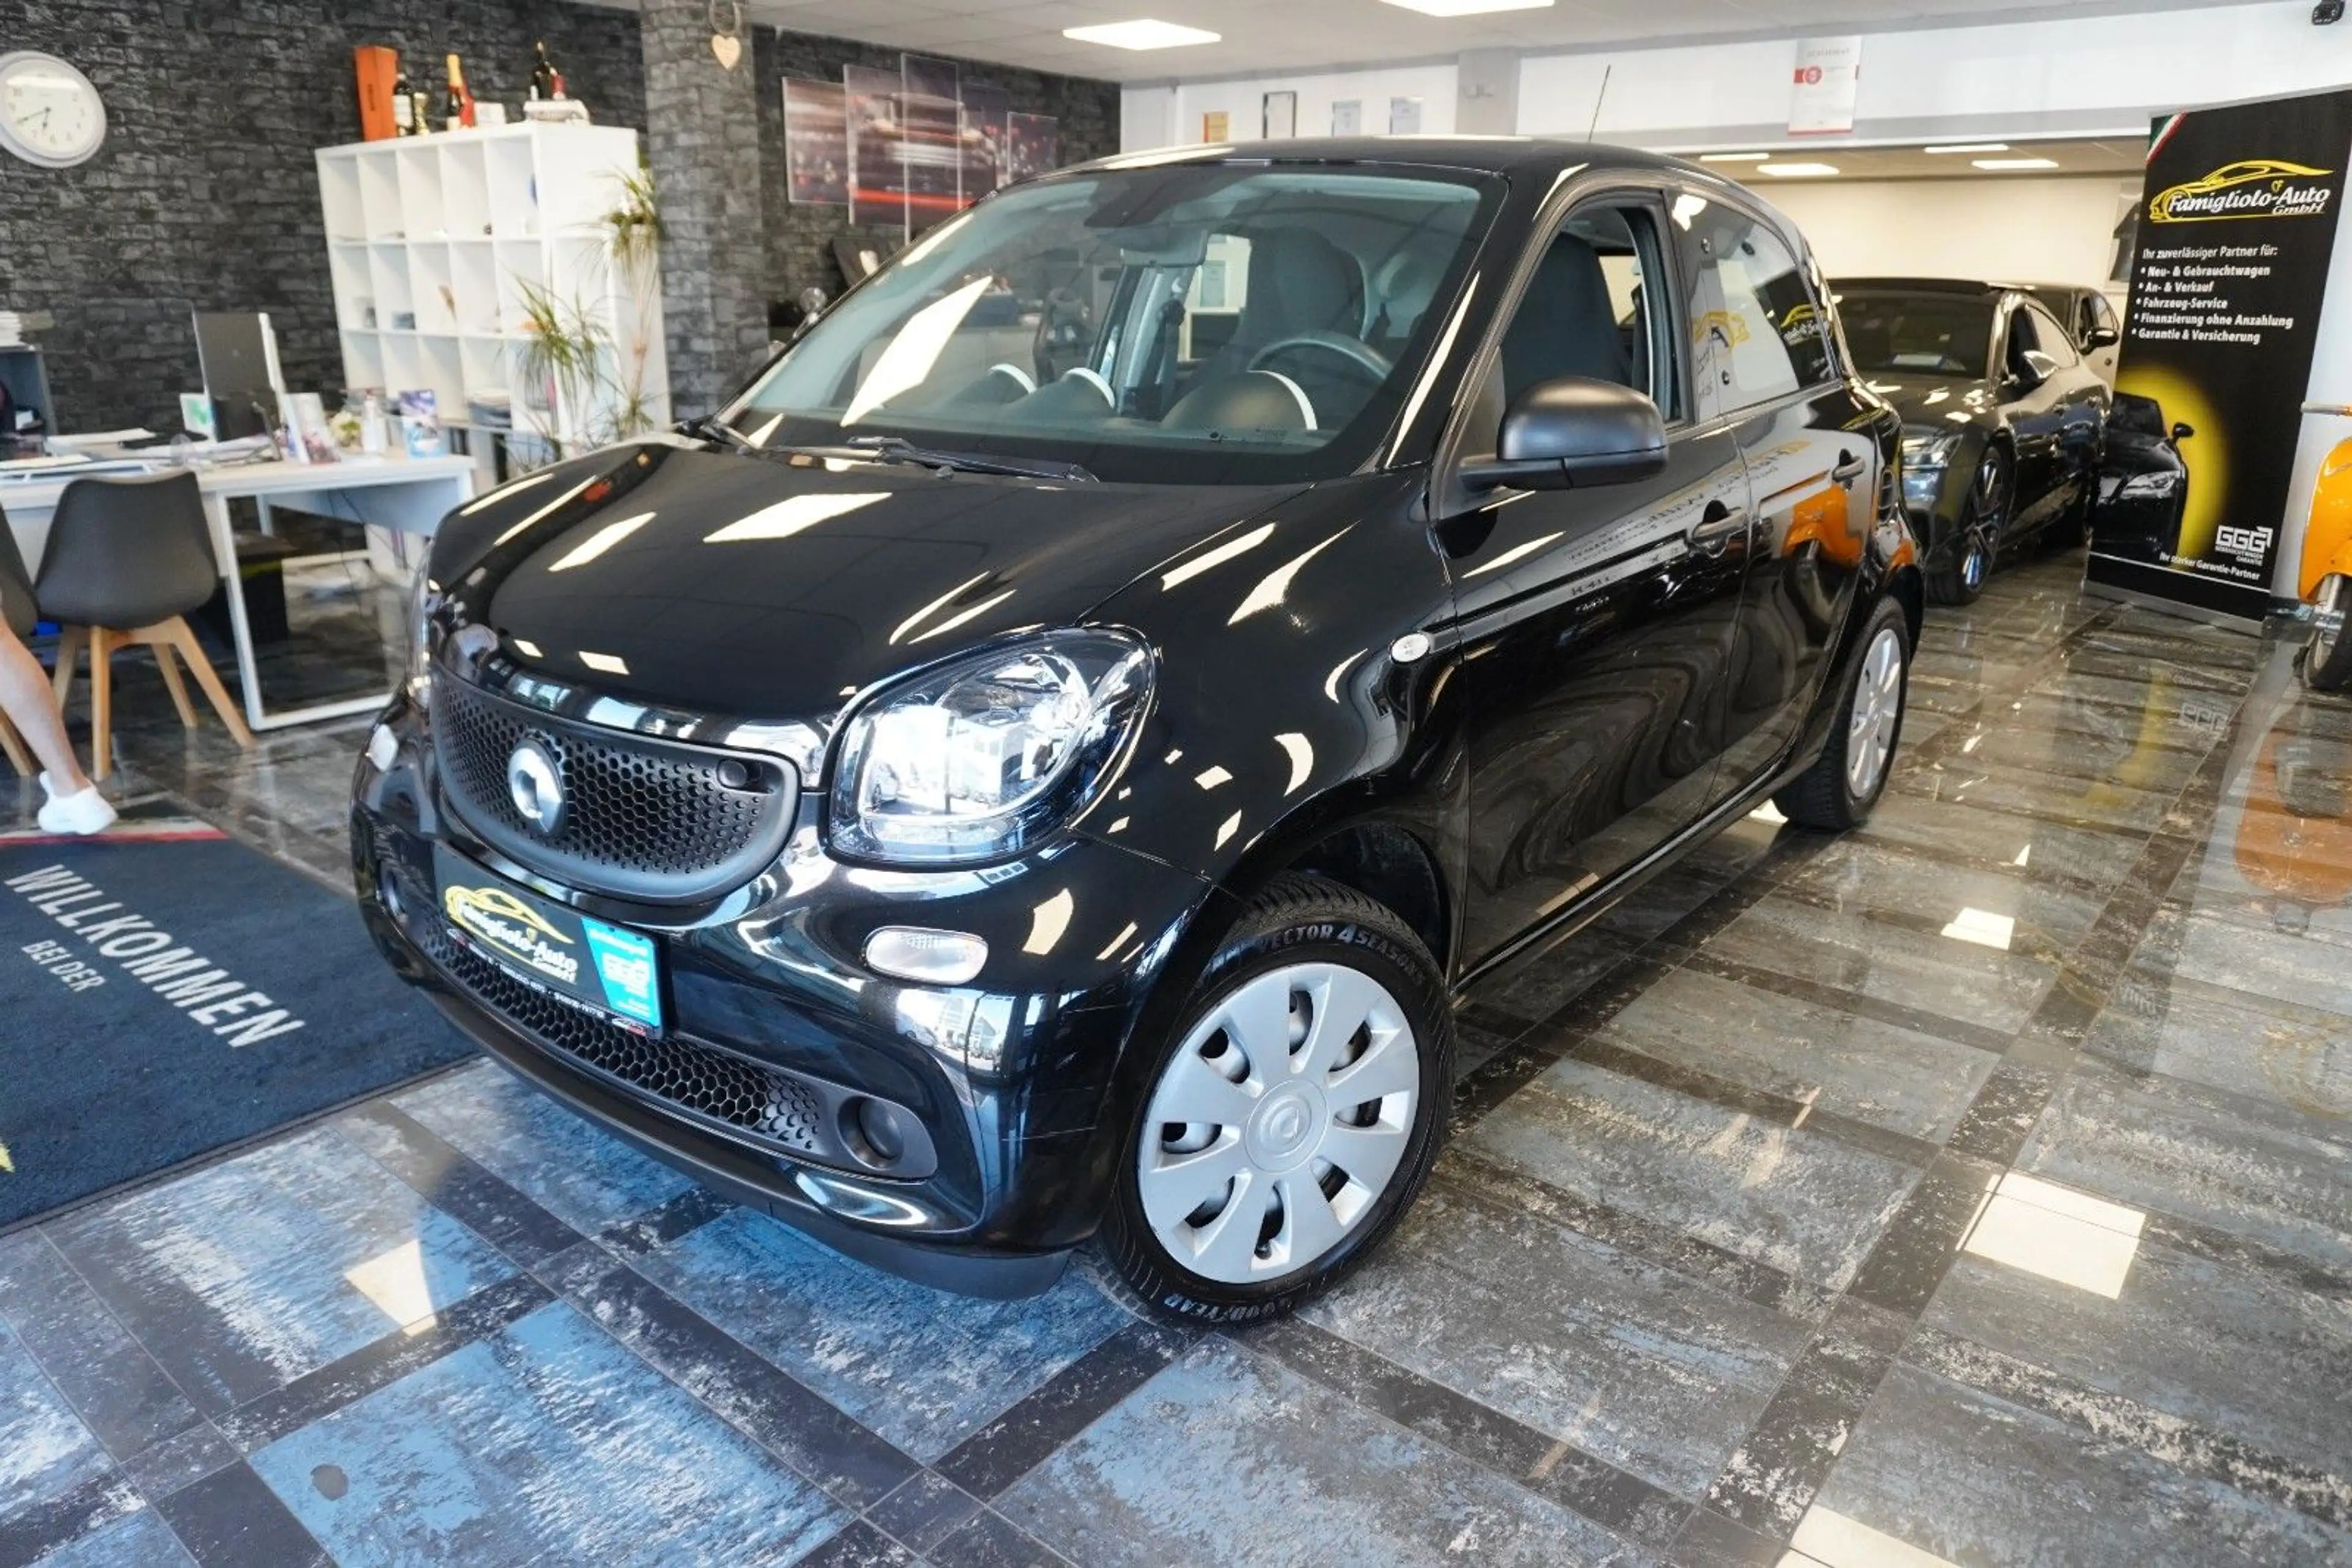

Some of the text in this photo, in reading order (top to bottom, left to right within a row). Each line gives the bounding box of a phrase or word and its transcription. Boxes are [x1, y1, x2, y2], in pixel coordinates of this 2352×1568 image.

[2168, 186, 2331, 213] Famigliolo-Auto
[2271, 202, 2325, 215] GmbH
[2143, 245, 2278, 260] Ihr zuverlässiger Partner für:
[2147, 265, 2271, 278] Neu- & Gebrauchtwagen
[2145, 281, 2215, 293] An- & Verkauf
[2143, 297, 2228, 310] Fahrzeug-Service
[2140, 313, 2294, 329] Finanzierung ohne Anzahlung
[2138, 328, 2261, 345] Garantie & Versicherung
[2215, 525, 2267, 553] GGG
[2196, 559, 2261, 580] Garantie-Partner
[4, 864, 306, 1047] WILLKOMMEN
[21, 940, 107, 992] BEI DER
